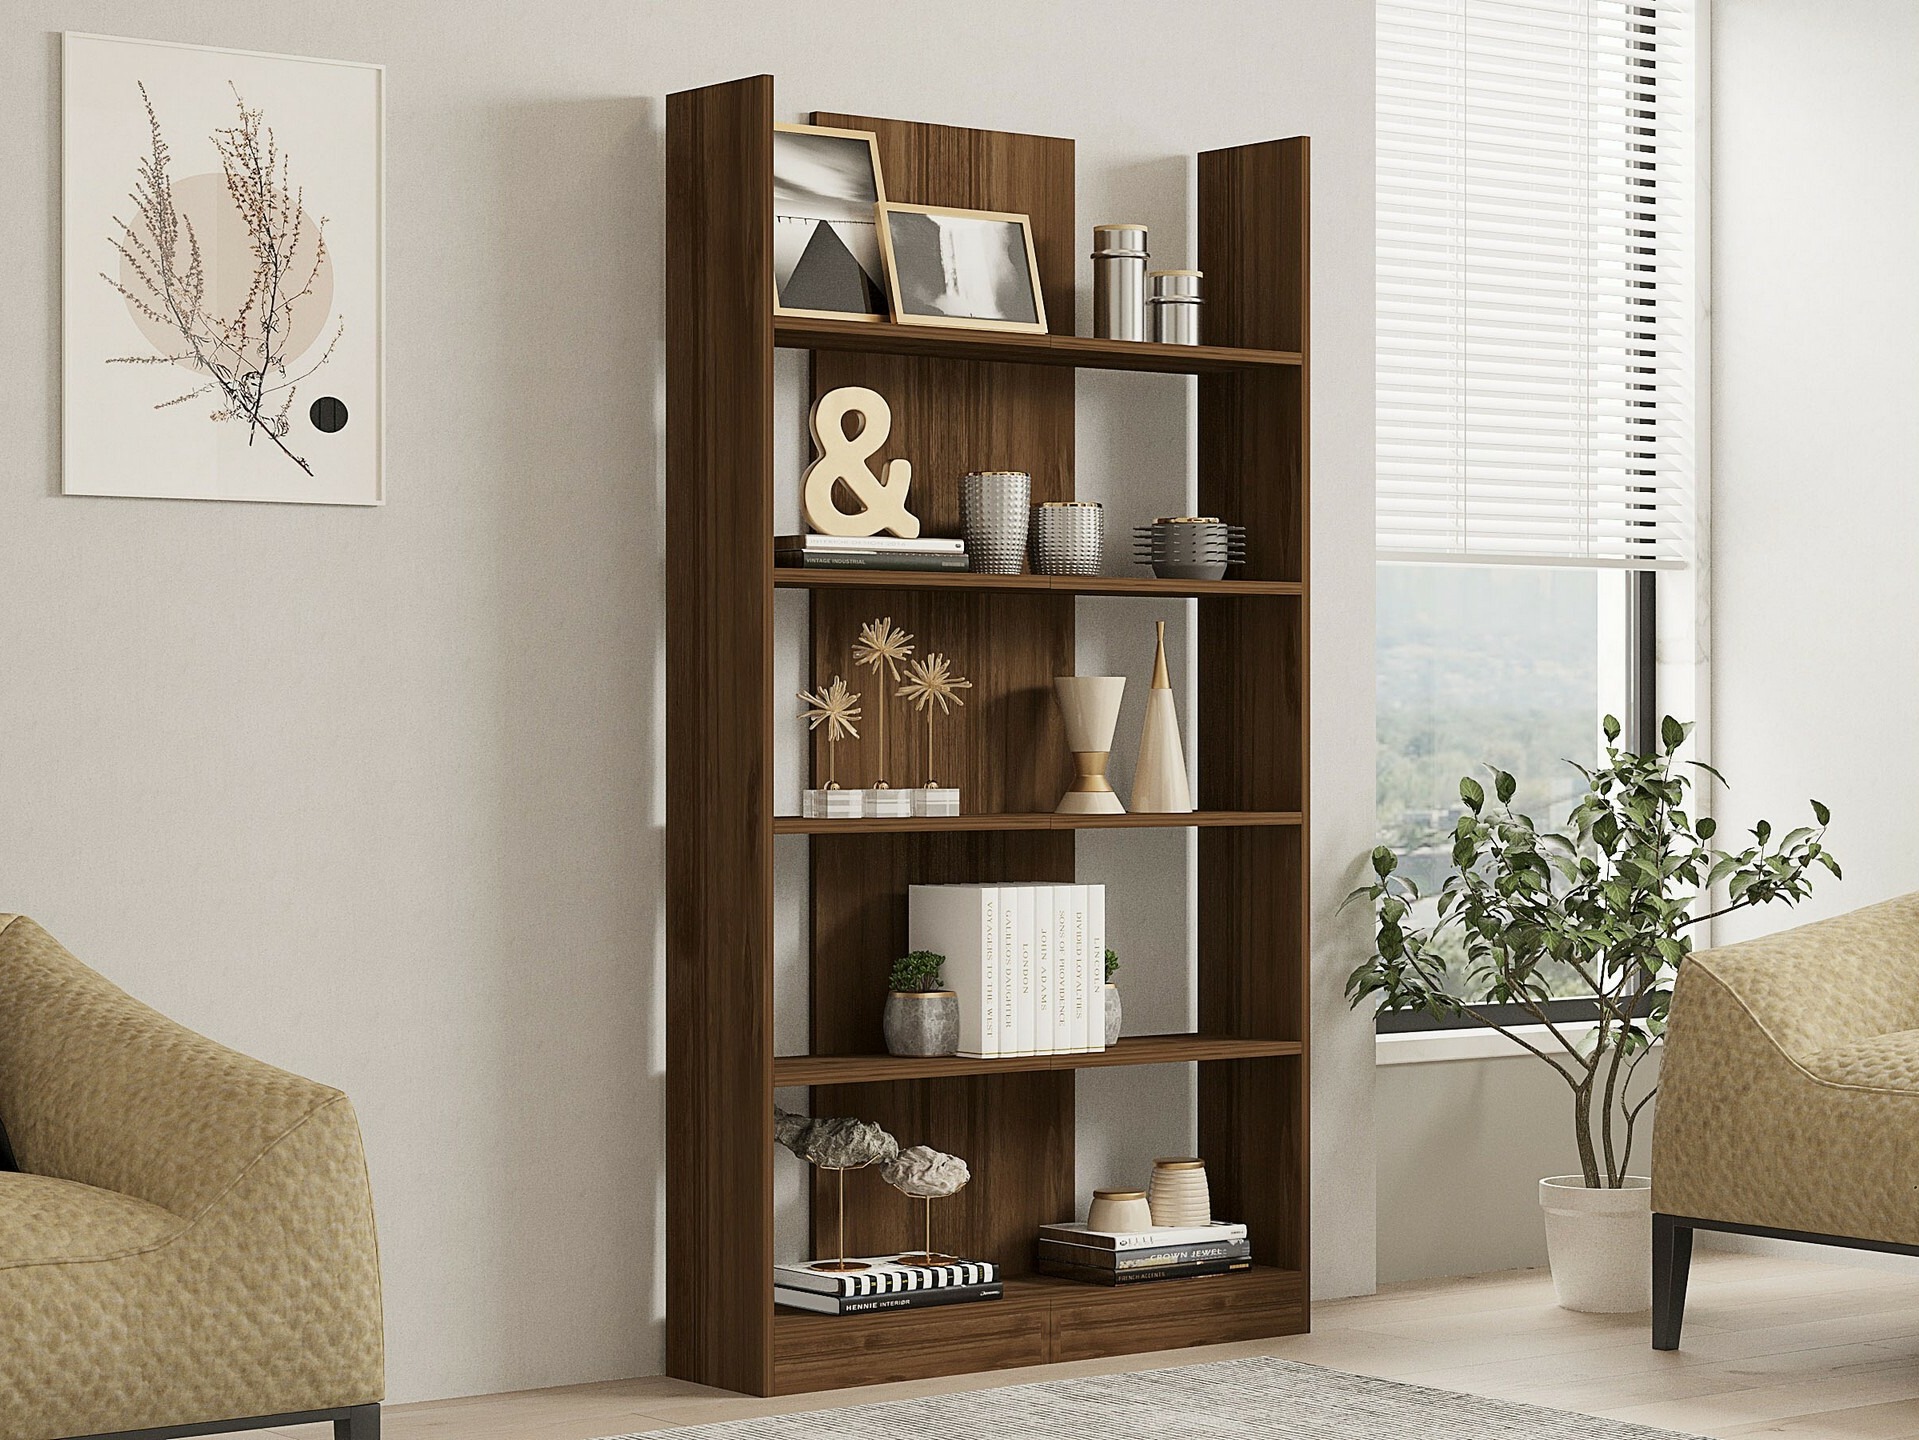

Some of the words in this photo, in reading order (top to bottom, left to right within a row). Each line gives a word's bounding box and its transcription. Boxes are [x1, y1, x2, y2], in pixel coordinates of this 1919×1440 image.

[1059, 941, 1065, 956] OF
[987, 965, 993, 980] TO
[845, 1302, 878, 1311] HENNIE
